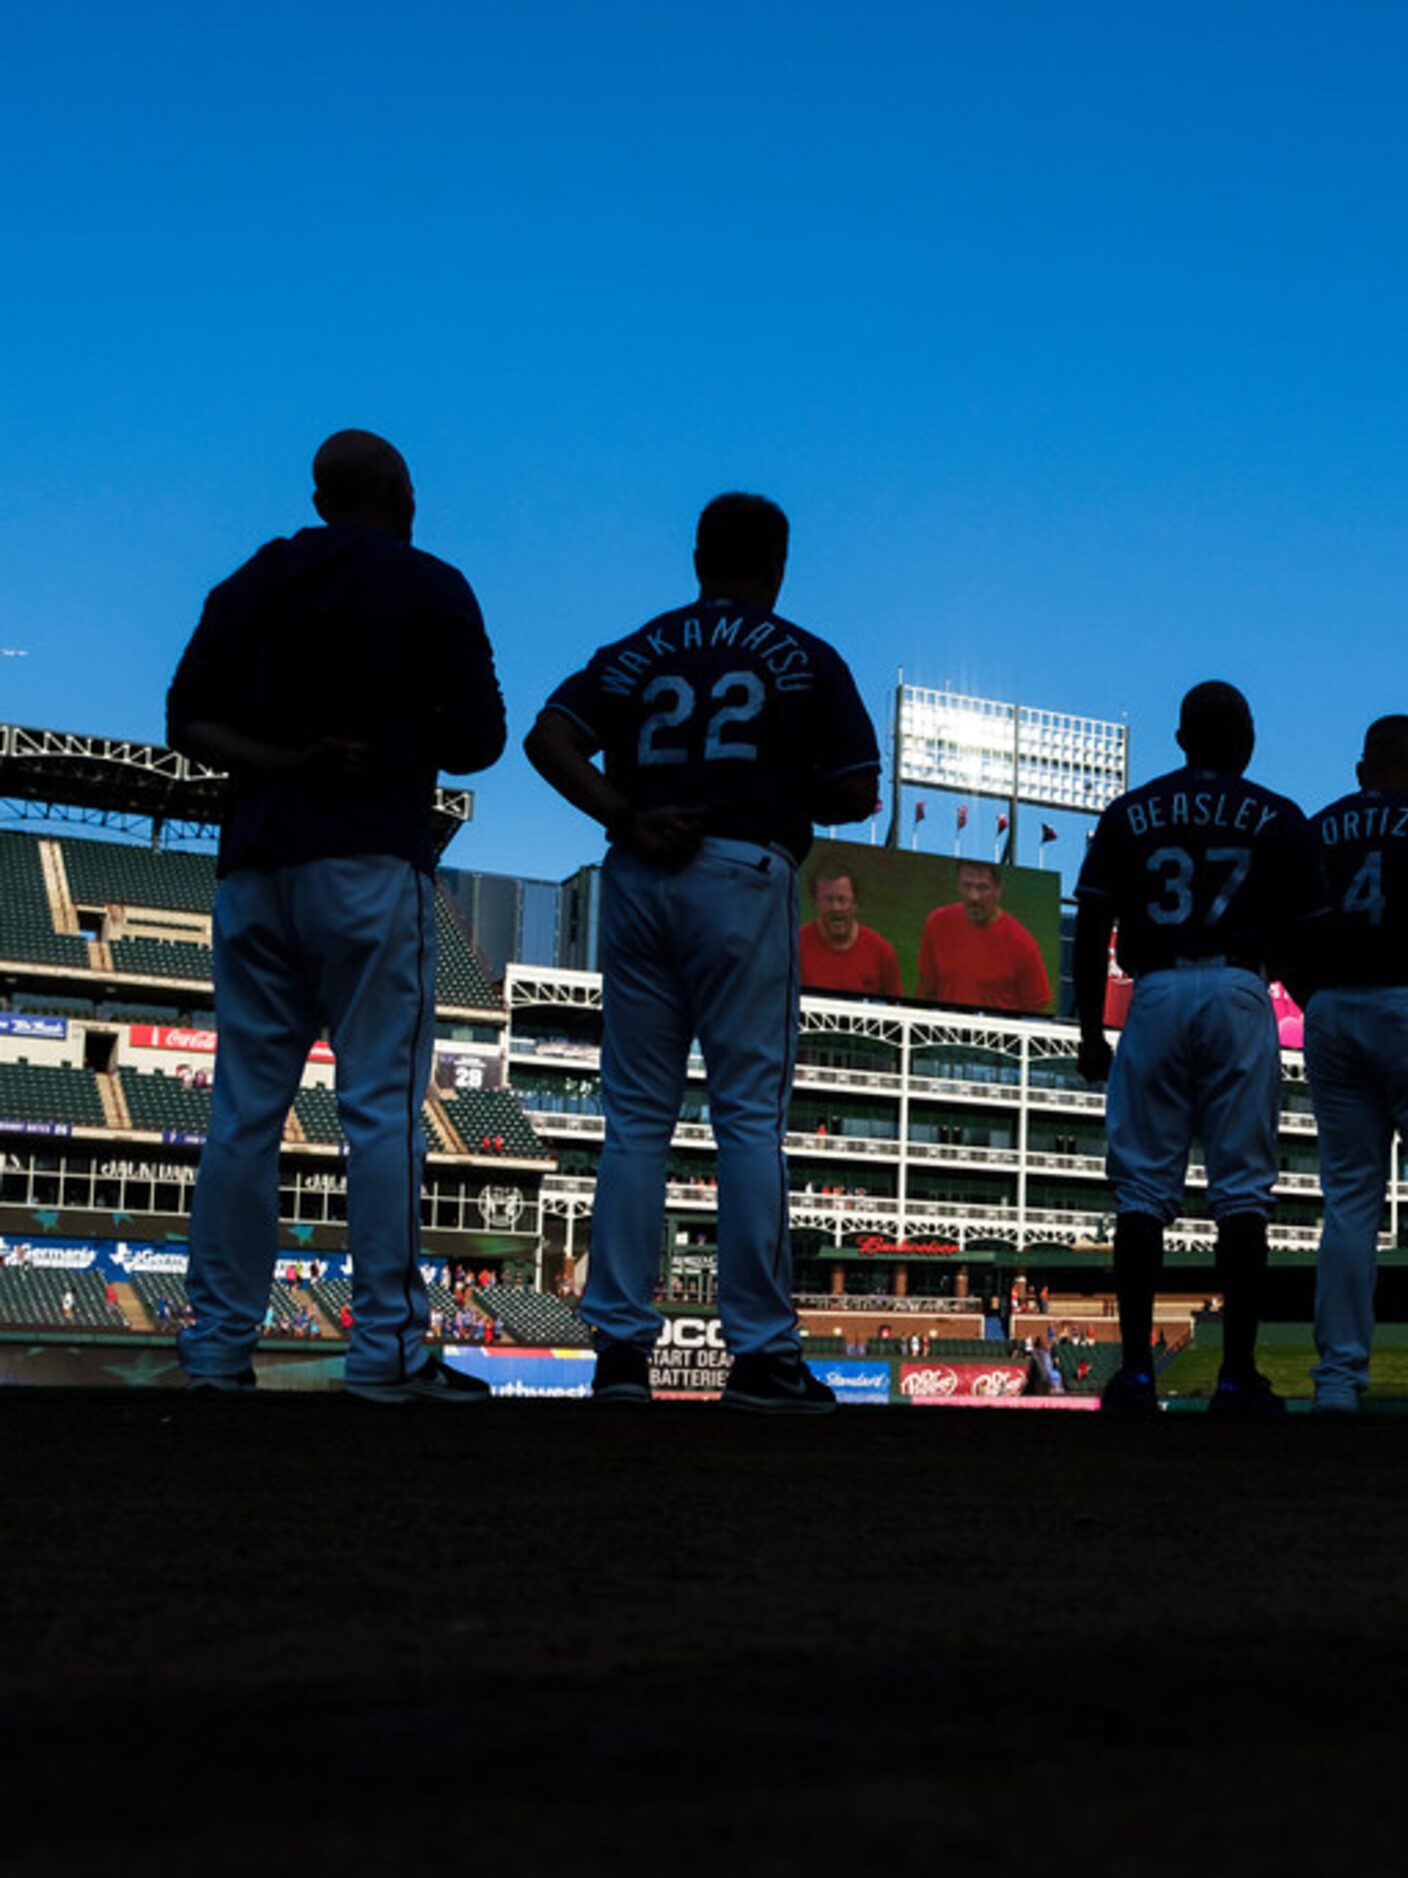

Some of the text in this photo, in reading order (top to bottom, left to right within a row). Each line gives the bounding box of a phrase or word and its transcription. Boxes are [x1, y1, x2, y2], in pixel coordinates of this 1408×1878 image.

[600, 615, 815, 698] WAKAMATSU
[636, 669, 769, 769] 22
[1125, 792, 1278, 840] BEASLEY
[1145, 845, 1254, 928] 37
[1342, 849, 1387, 927] 4
[490, 1379, 586, 1398] uthwest
[647, 1349, 692, 1367] TART
[649, 1368, 730, 1387] BATTERIE
